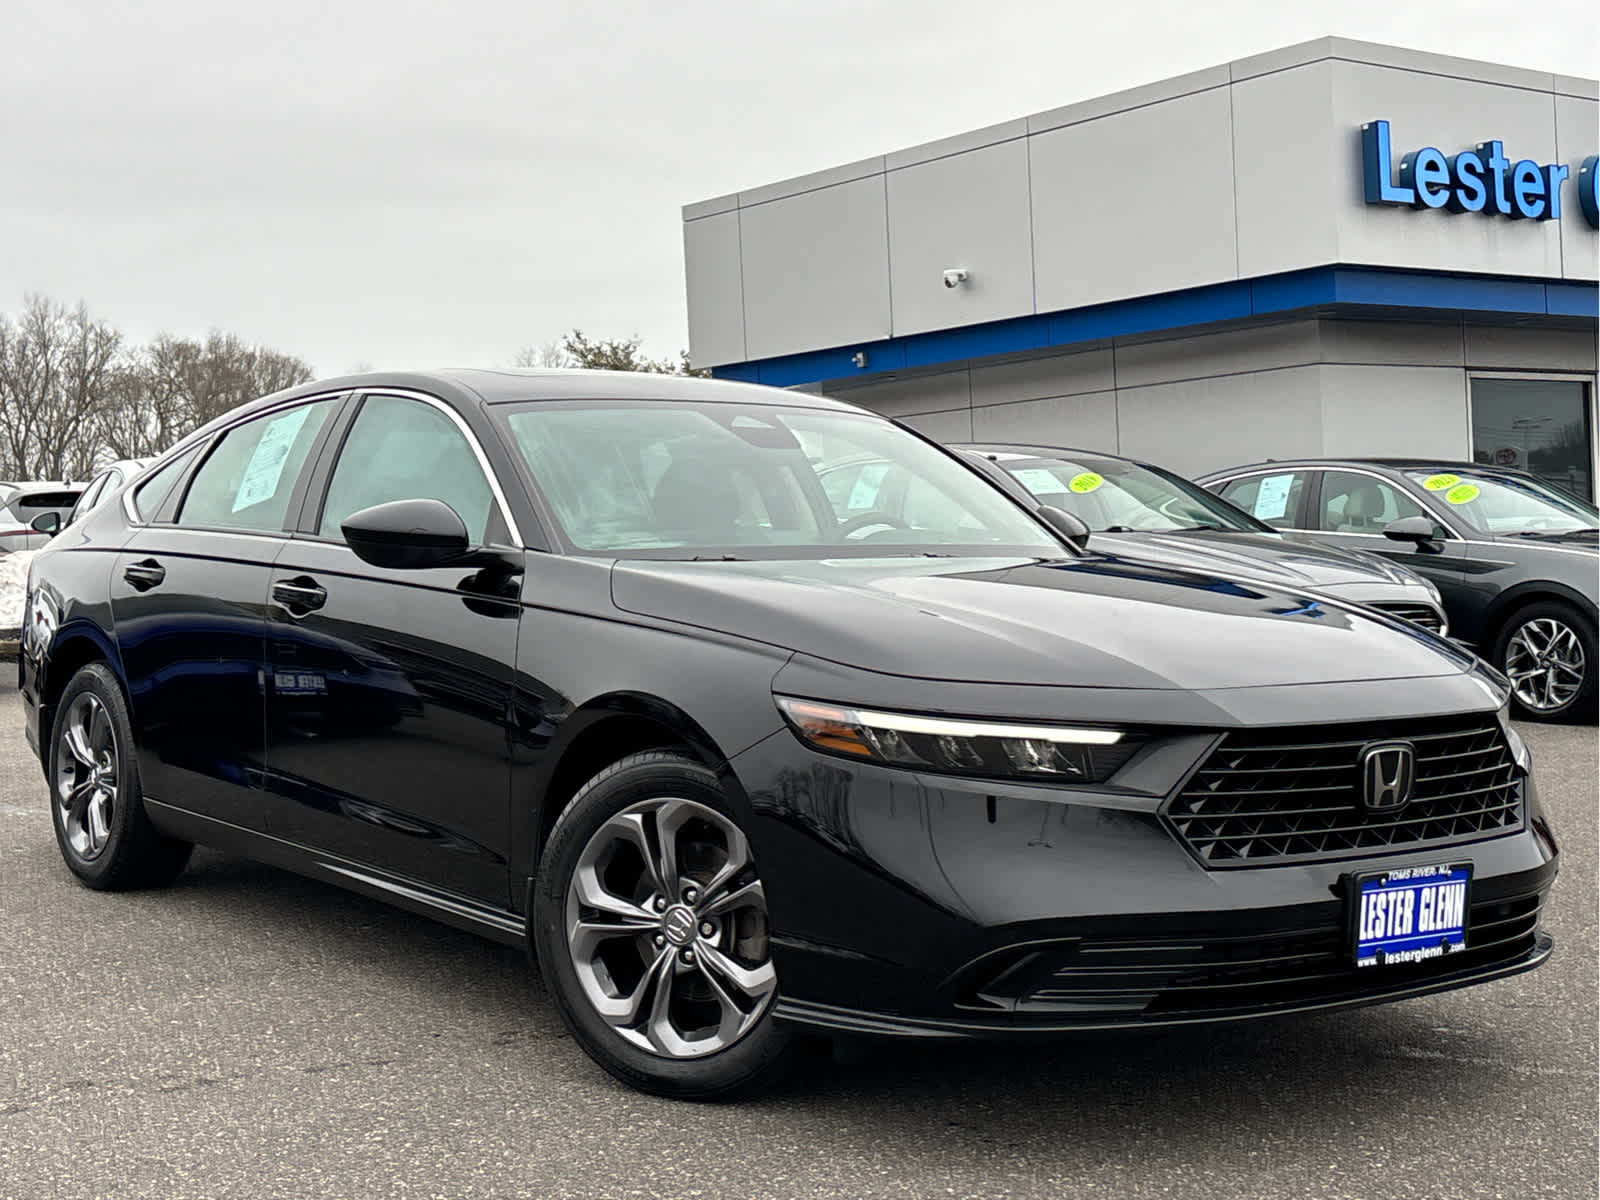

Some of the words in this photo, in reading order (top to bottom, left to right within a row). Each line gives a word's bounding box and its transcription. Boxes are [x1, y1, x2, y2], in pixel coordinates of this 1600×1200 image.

[1361, 120, 1569, 221] Lester
[1388, 869, 1411, 882] TOMS
[1359, 889, 1415, 941] LESTER
[1418, 883, 1466, 933] GLENN
[1385, 946, 1444, 965] lesterglenn
